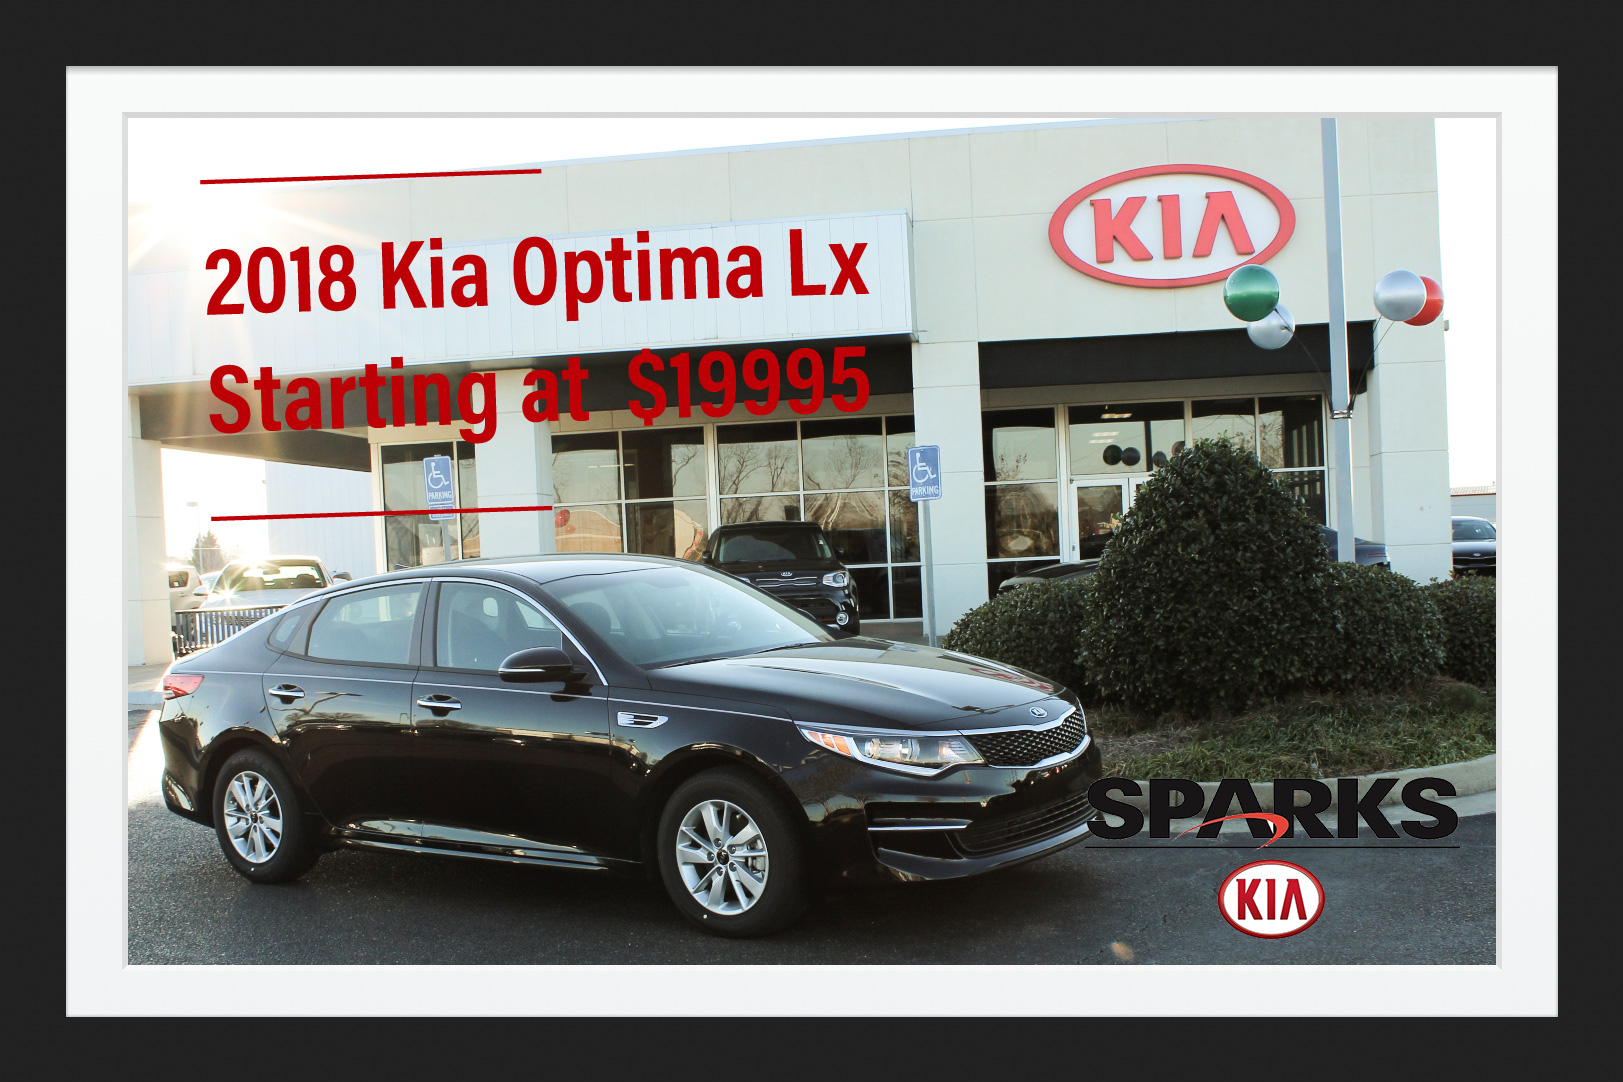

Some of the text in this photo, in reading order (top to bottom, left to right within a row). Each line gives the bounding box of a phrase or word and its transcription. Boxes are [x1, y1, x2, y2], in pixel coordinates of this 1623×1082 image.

[1089, 191, 1255, 263] KIA
[428, 491, 452, 501] PARKING
[912, 485, 939, 496] PARKING
